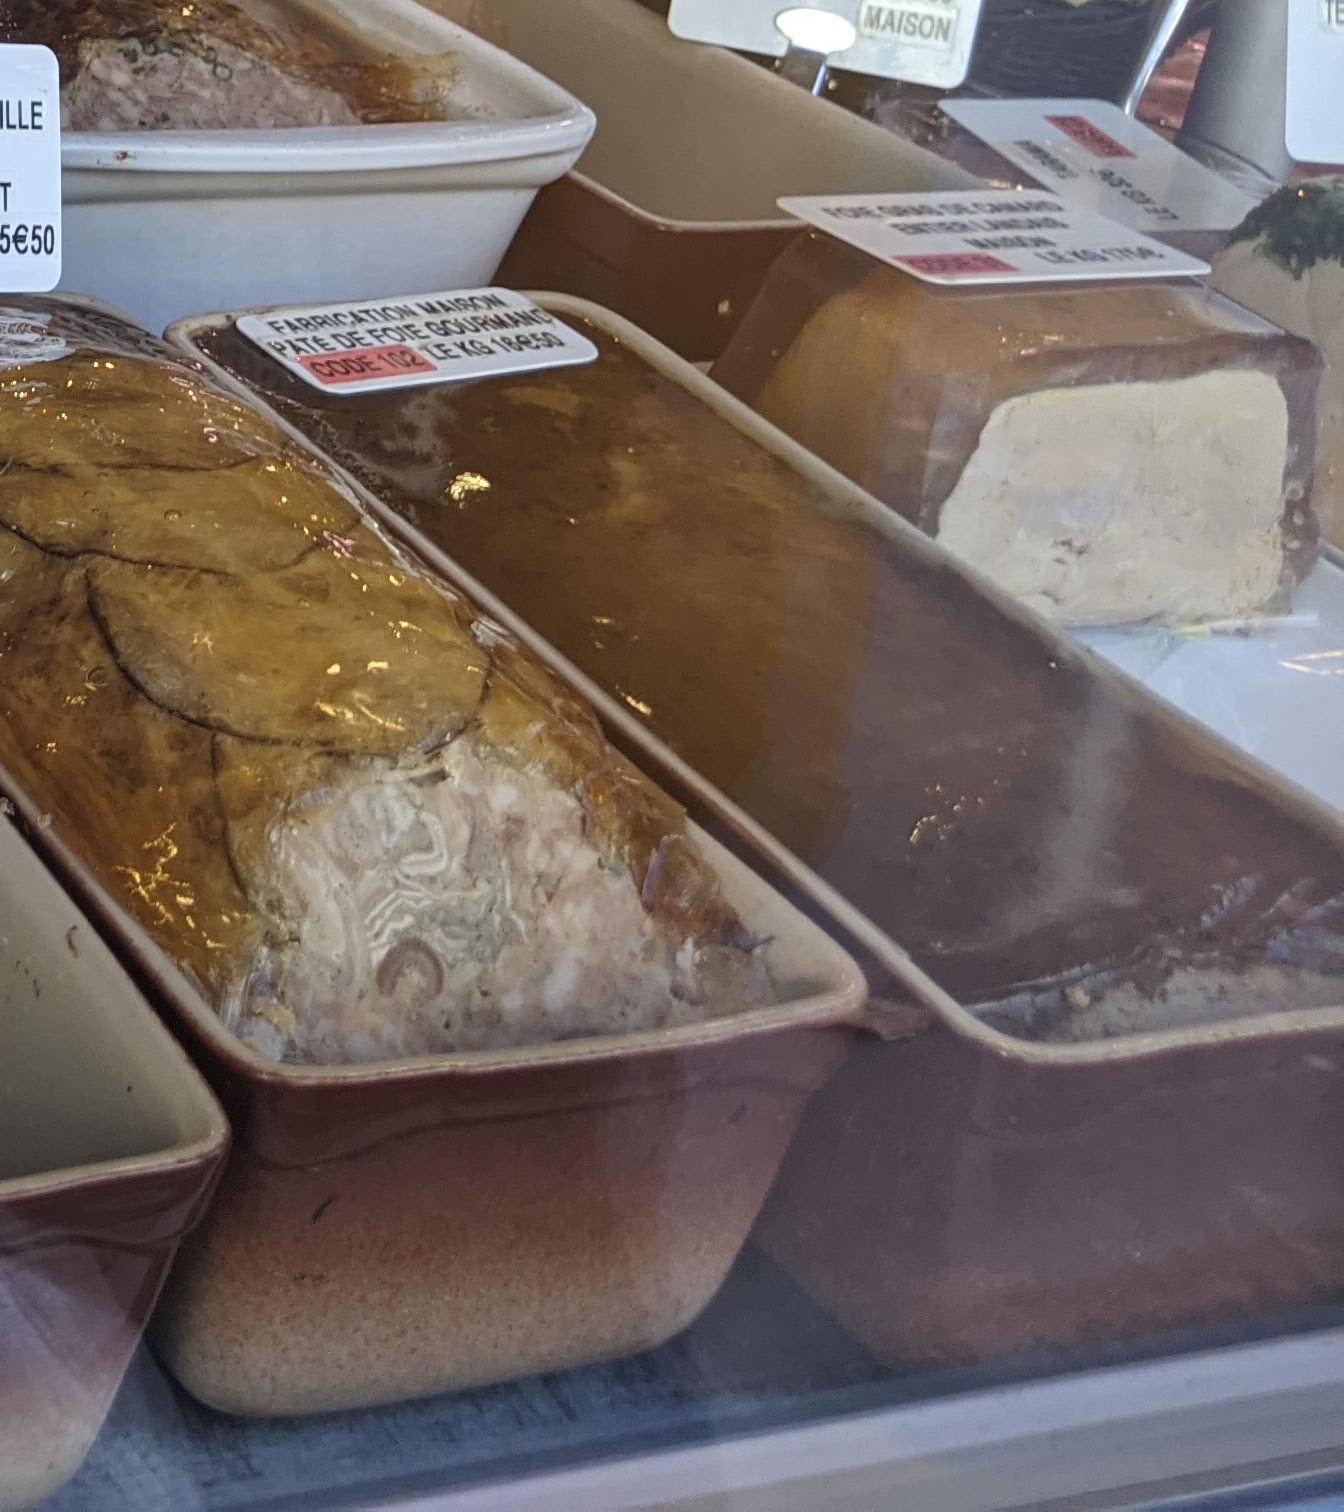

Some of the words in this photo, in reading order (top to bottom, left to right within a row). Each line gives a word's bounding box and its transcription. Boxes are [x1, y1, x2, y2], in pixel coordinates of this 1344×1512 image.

[862, 4, 952, 42] MAISON
[267, 304, 418, 337] FABRICATION
[415, 293, 509, 316] MAISON
[331, 330, 372, 349] DE
[367, 323, 430, 346] FOIE
[421, 343, 461, 361] LE
[453, 339, 496, 357] KG
[309, 355, 381, 378] CODE
[377, 350, 424, 370] 102
